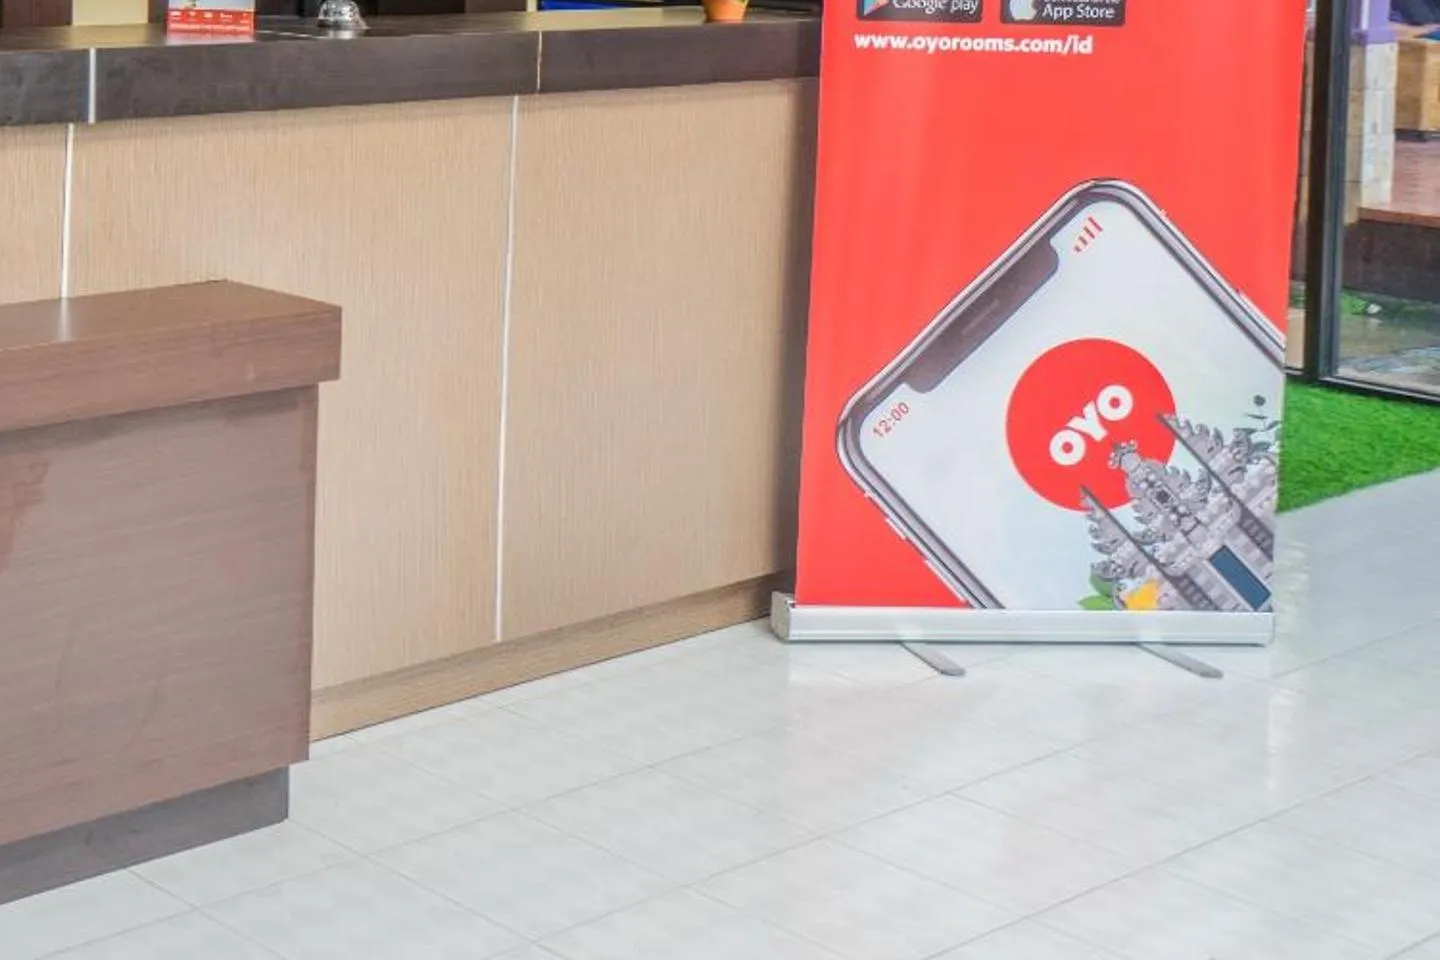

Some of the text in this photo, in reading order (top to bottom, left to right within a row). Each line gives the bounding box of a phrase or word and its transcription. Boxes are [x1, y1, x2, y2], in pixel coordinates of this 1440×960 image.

[1042, 3, 1116, 20] App Store
[853, 33, 1093, 55] www.oyorooms.com/id
[871, 400, 911, 440] 12:00
[1049, 383, 1134, 467] OYO
